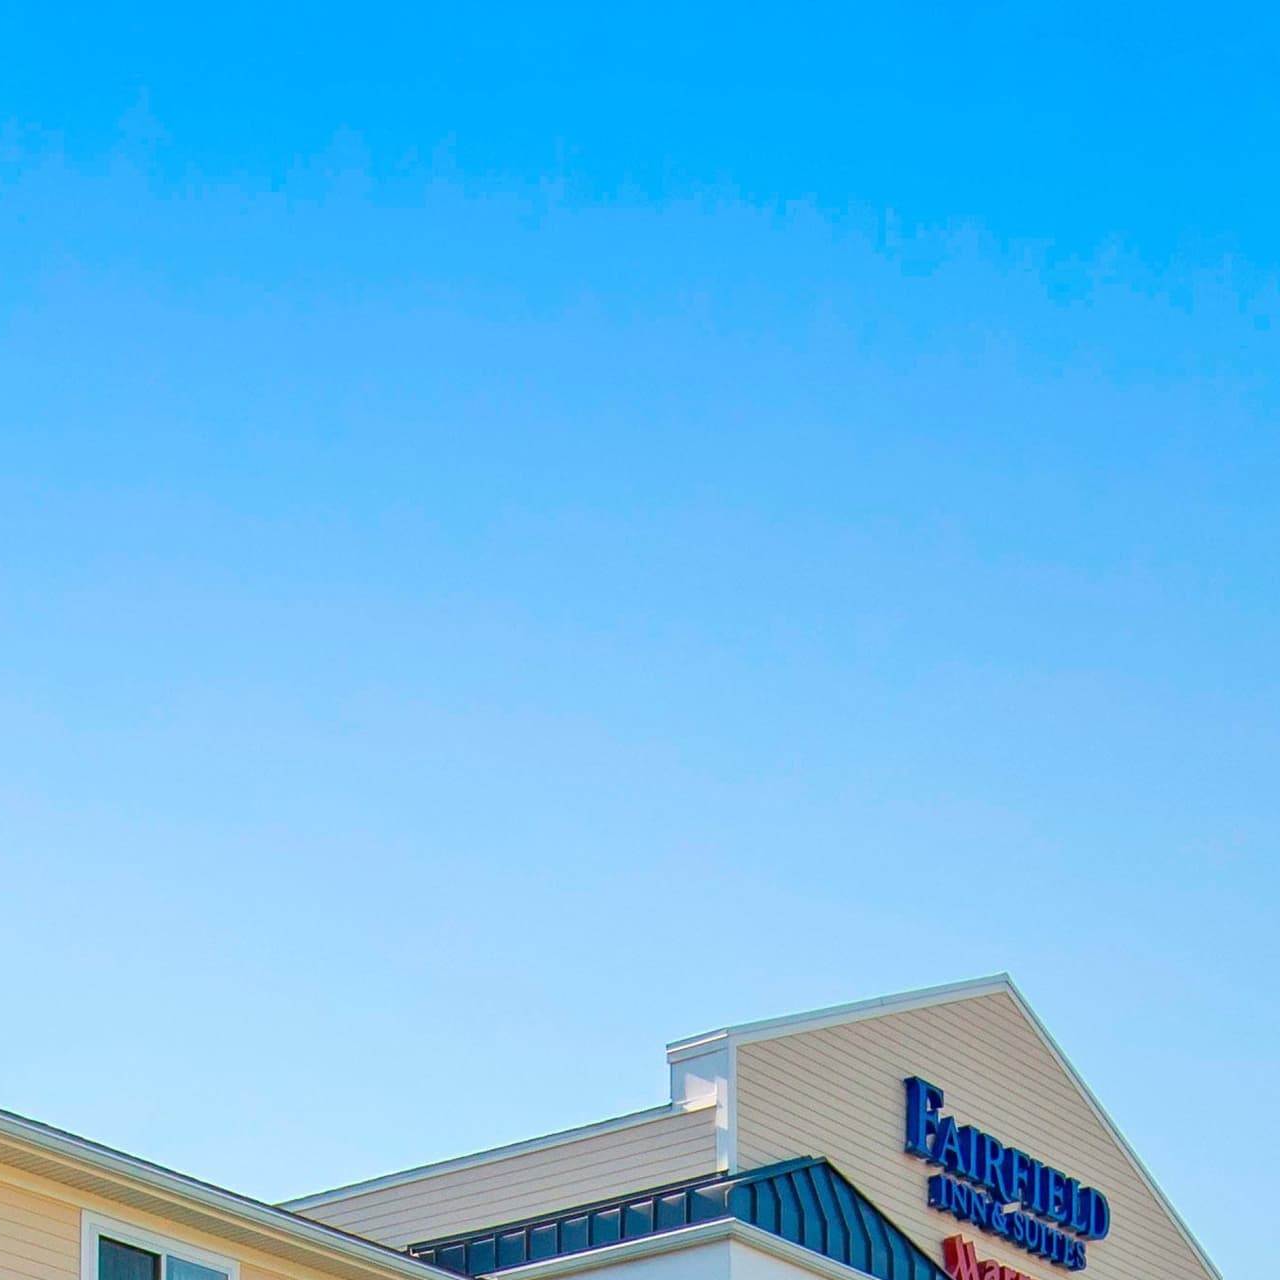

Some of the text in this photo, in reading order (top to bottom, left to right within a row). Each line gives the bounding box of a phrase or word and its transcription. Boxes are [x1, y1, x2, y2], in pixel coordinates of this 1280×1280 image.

[904, 1076, 1110, 1241] FAIRFIELD
[928, 1174, 1087, 1271] INN & SUITES
